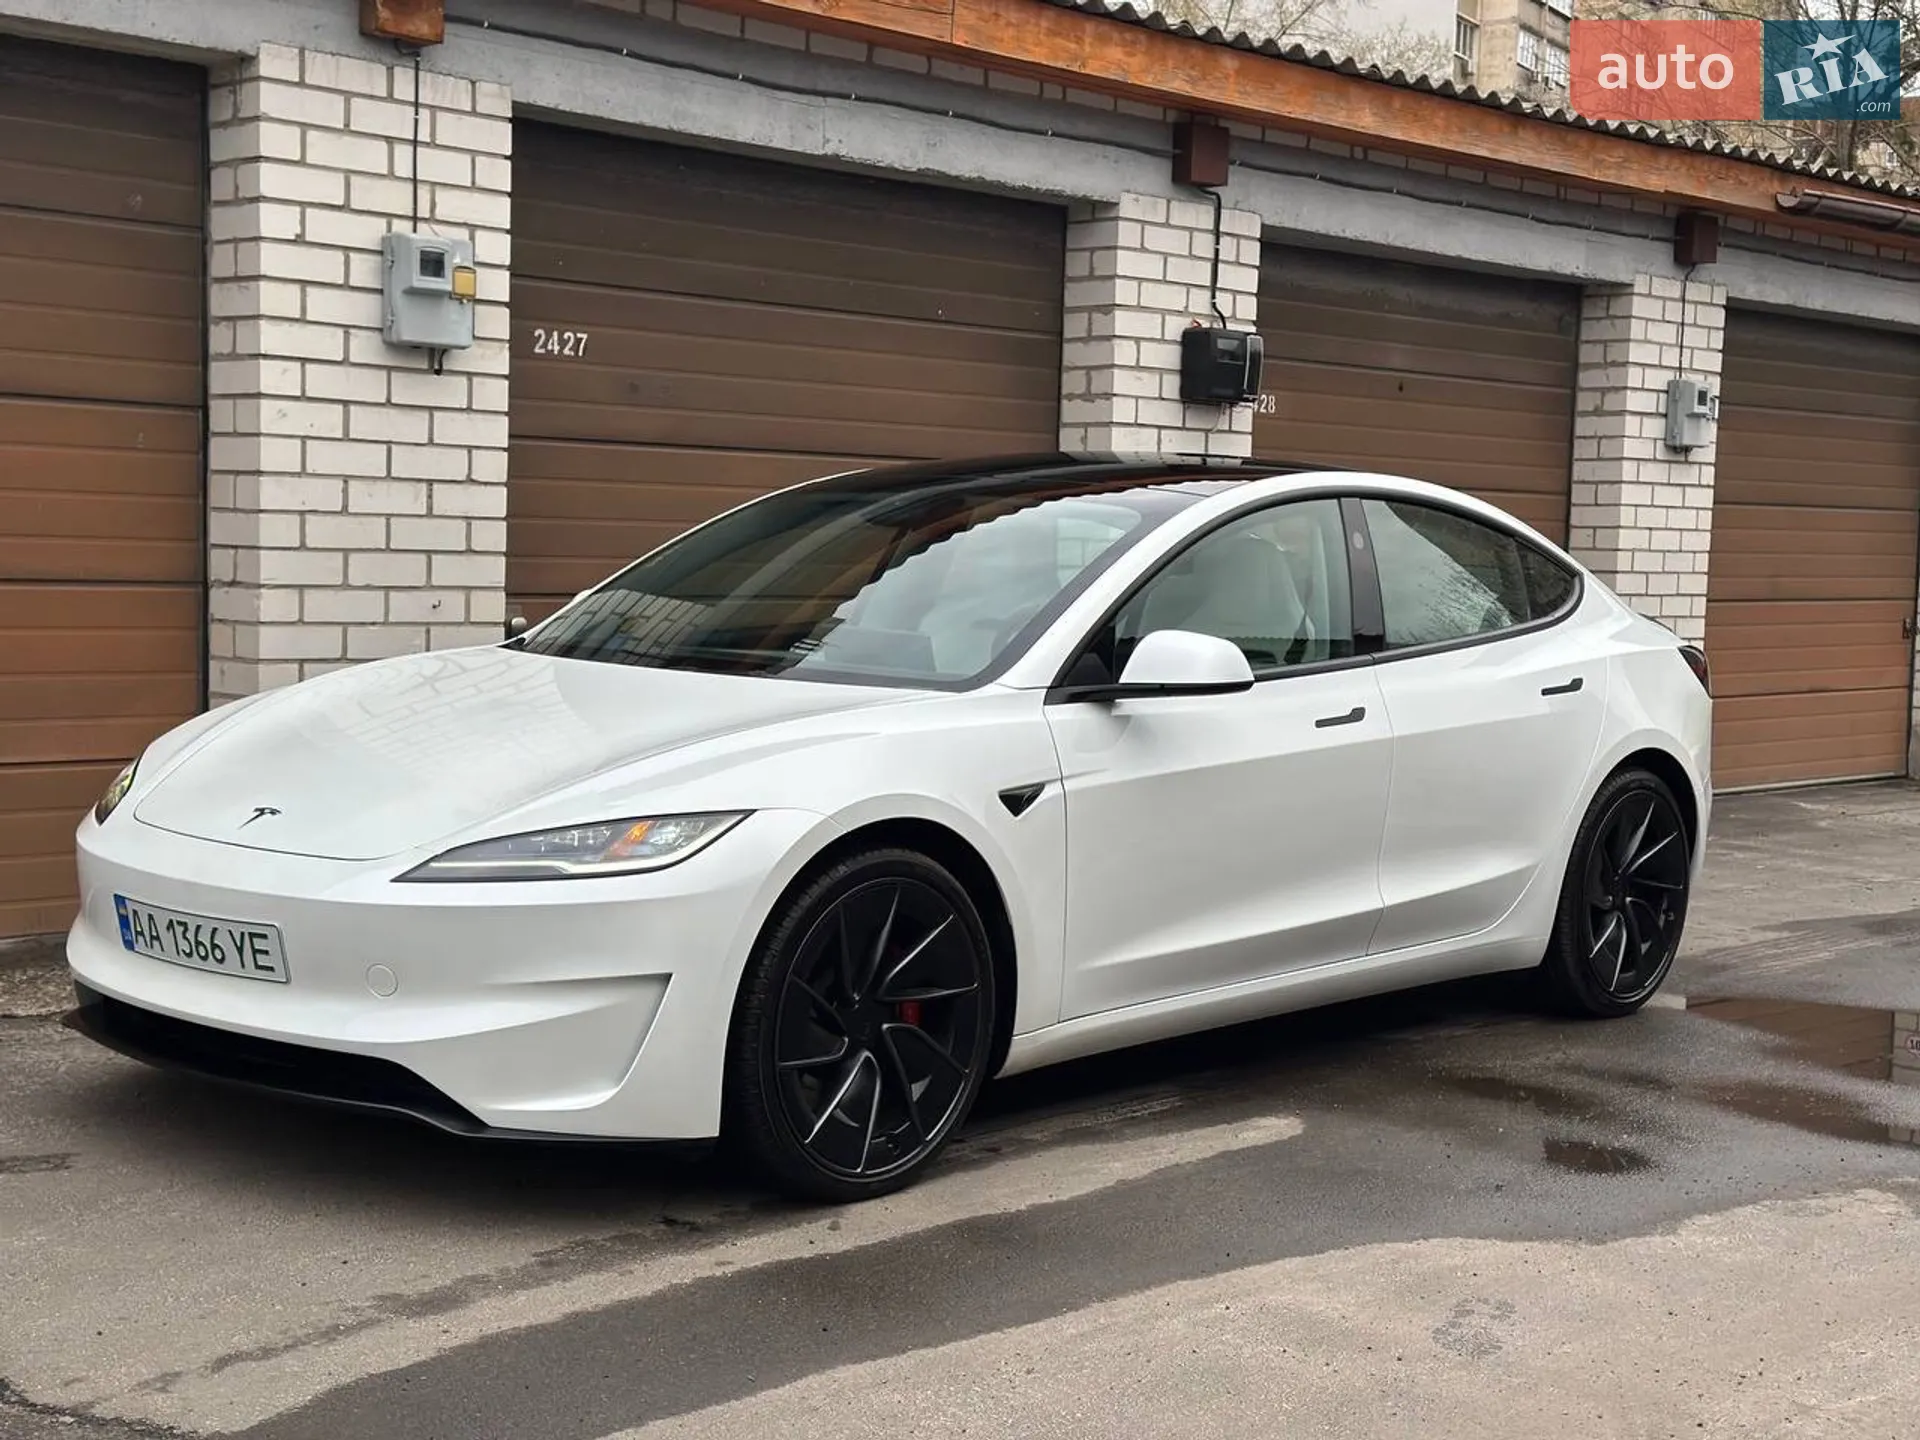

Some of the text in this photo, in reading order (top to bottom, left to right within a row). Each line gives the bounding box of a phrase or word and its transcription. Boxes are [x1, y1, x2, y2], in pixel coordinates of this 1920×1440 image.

[533, 328, 589, 357] 2427
[132, 908, 276, 973] AA 1366 YE
